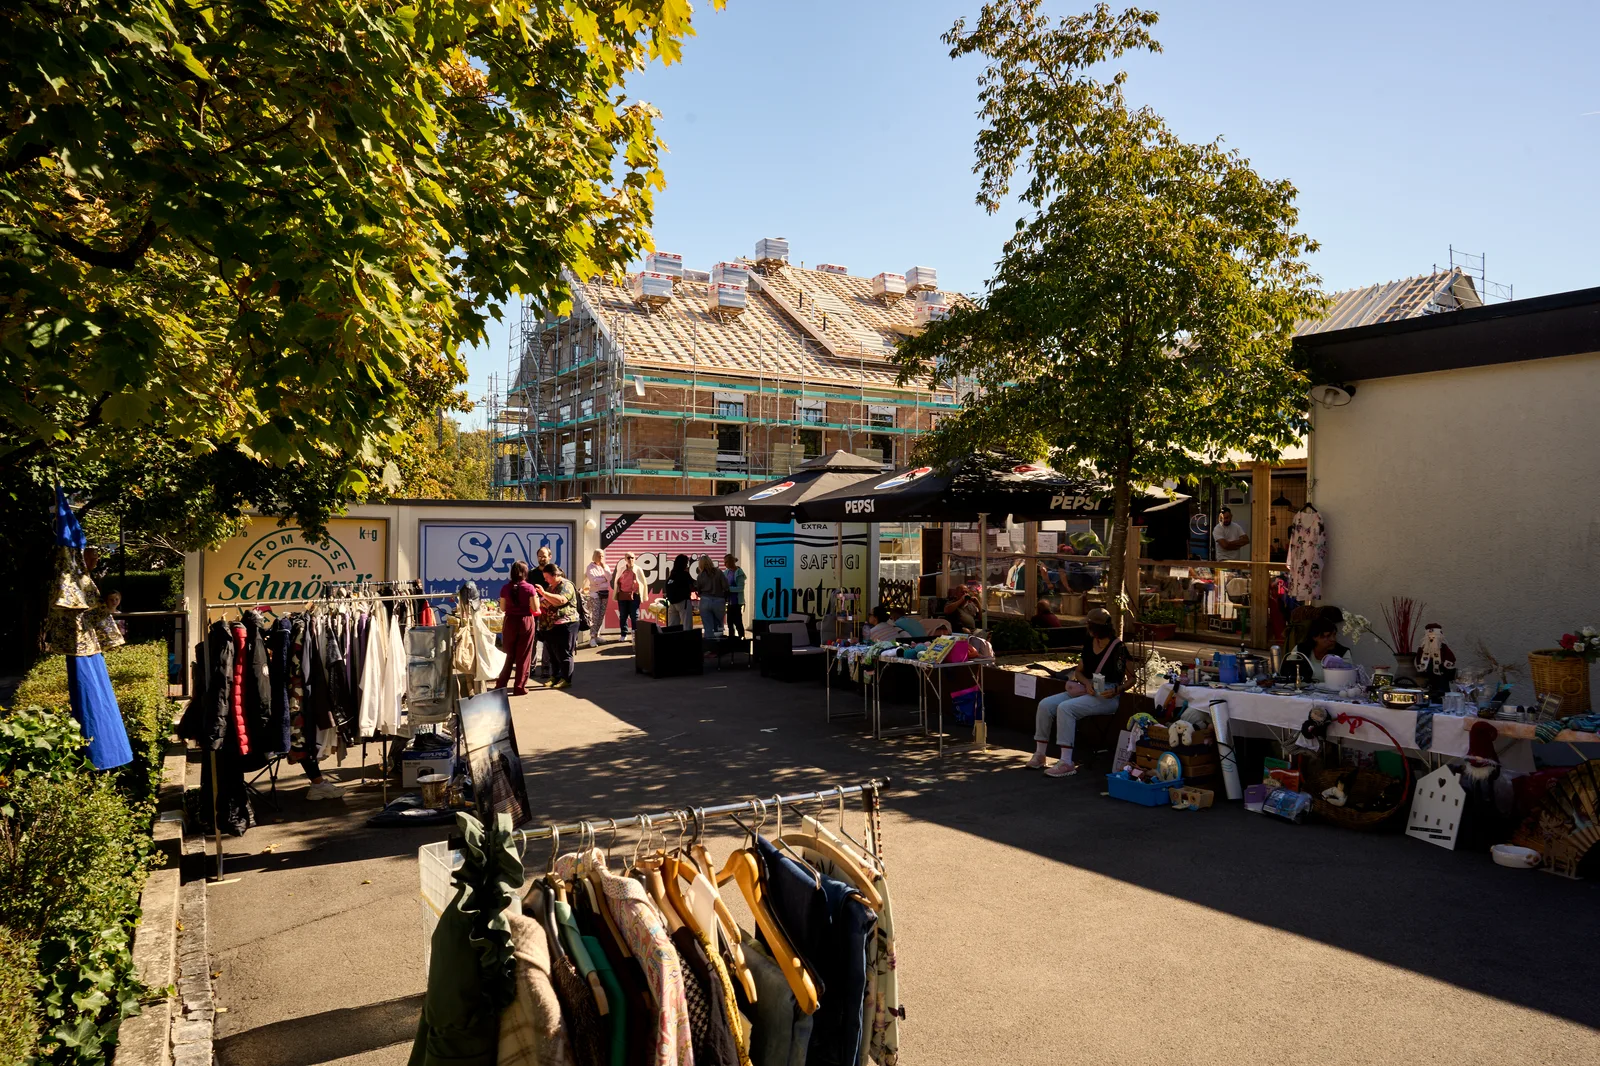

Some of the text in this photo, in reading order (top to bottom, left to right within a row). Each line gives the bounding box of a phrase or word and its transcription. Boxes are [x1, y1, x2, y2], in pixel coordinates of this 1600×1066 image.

[724, 506, 745, 517] PEPSI
[845, 499, 875, 514] PEPSI
[647, 530, 690, 541] FEINS
[247, 534, 294, 571] FROM
[287, 558, 311, 569] SPEZ.
